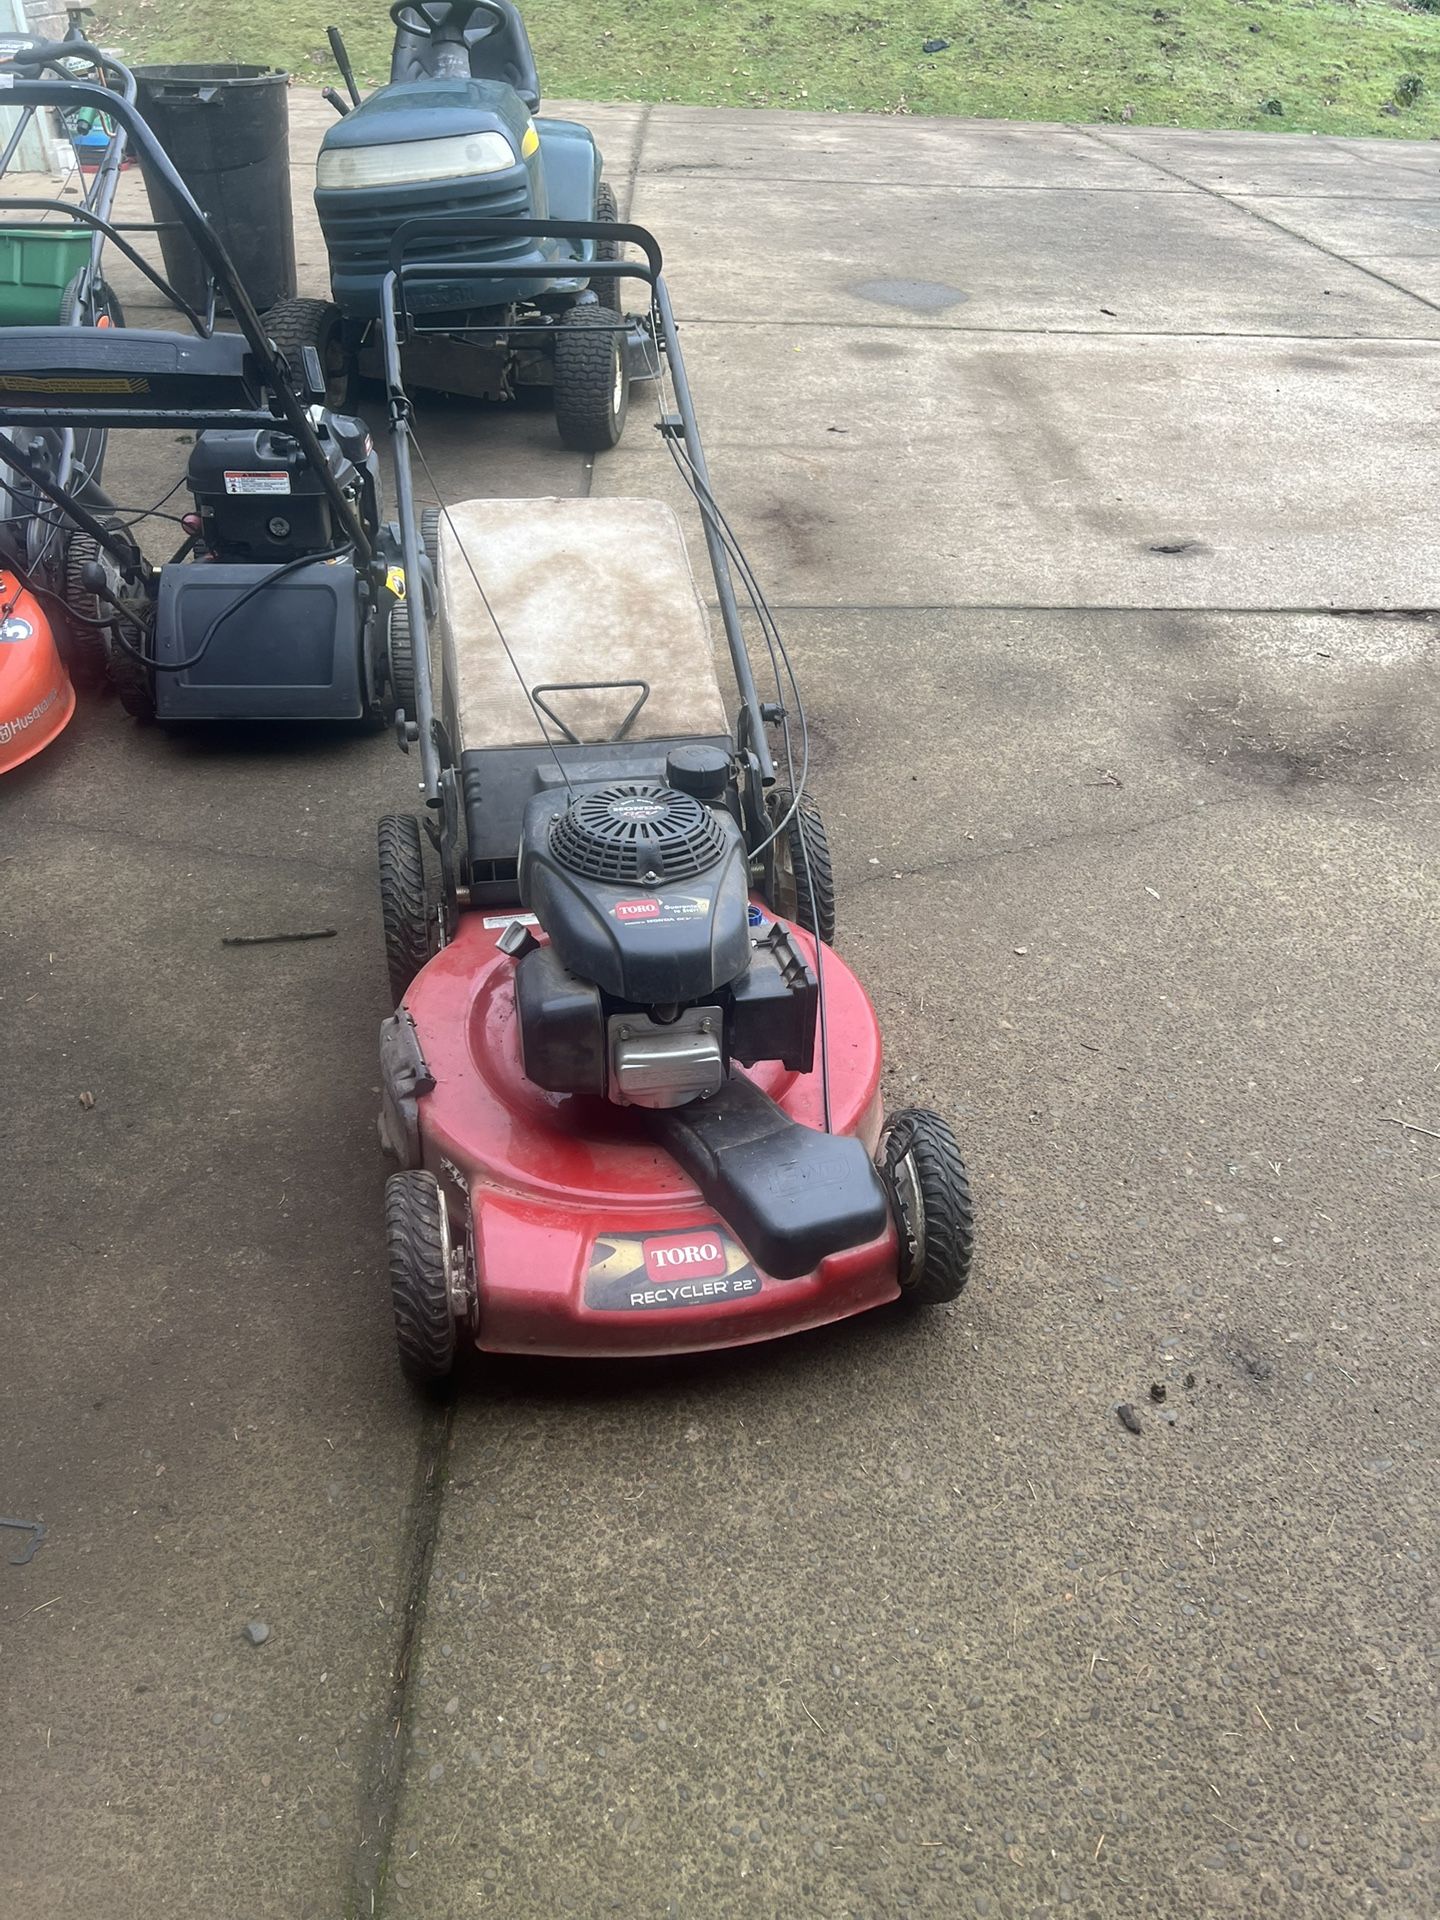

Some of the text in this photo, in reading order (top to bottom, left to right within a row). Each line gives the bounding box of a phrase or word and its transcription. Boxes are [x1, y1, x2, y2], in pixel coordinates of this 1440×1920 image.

[10, 687, 57, 735] Husqva
[619, 904, 656, 915] TORO
[651, 1243, 719, 1267] TORO
[630, 1279, 757, 1306] RECYCLER 22"
